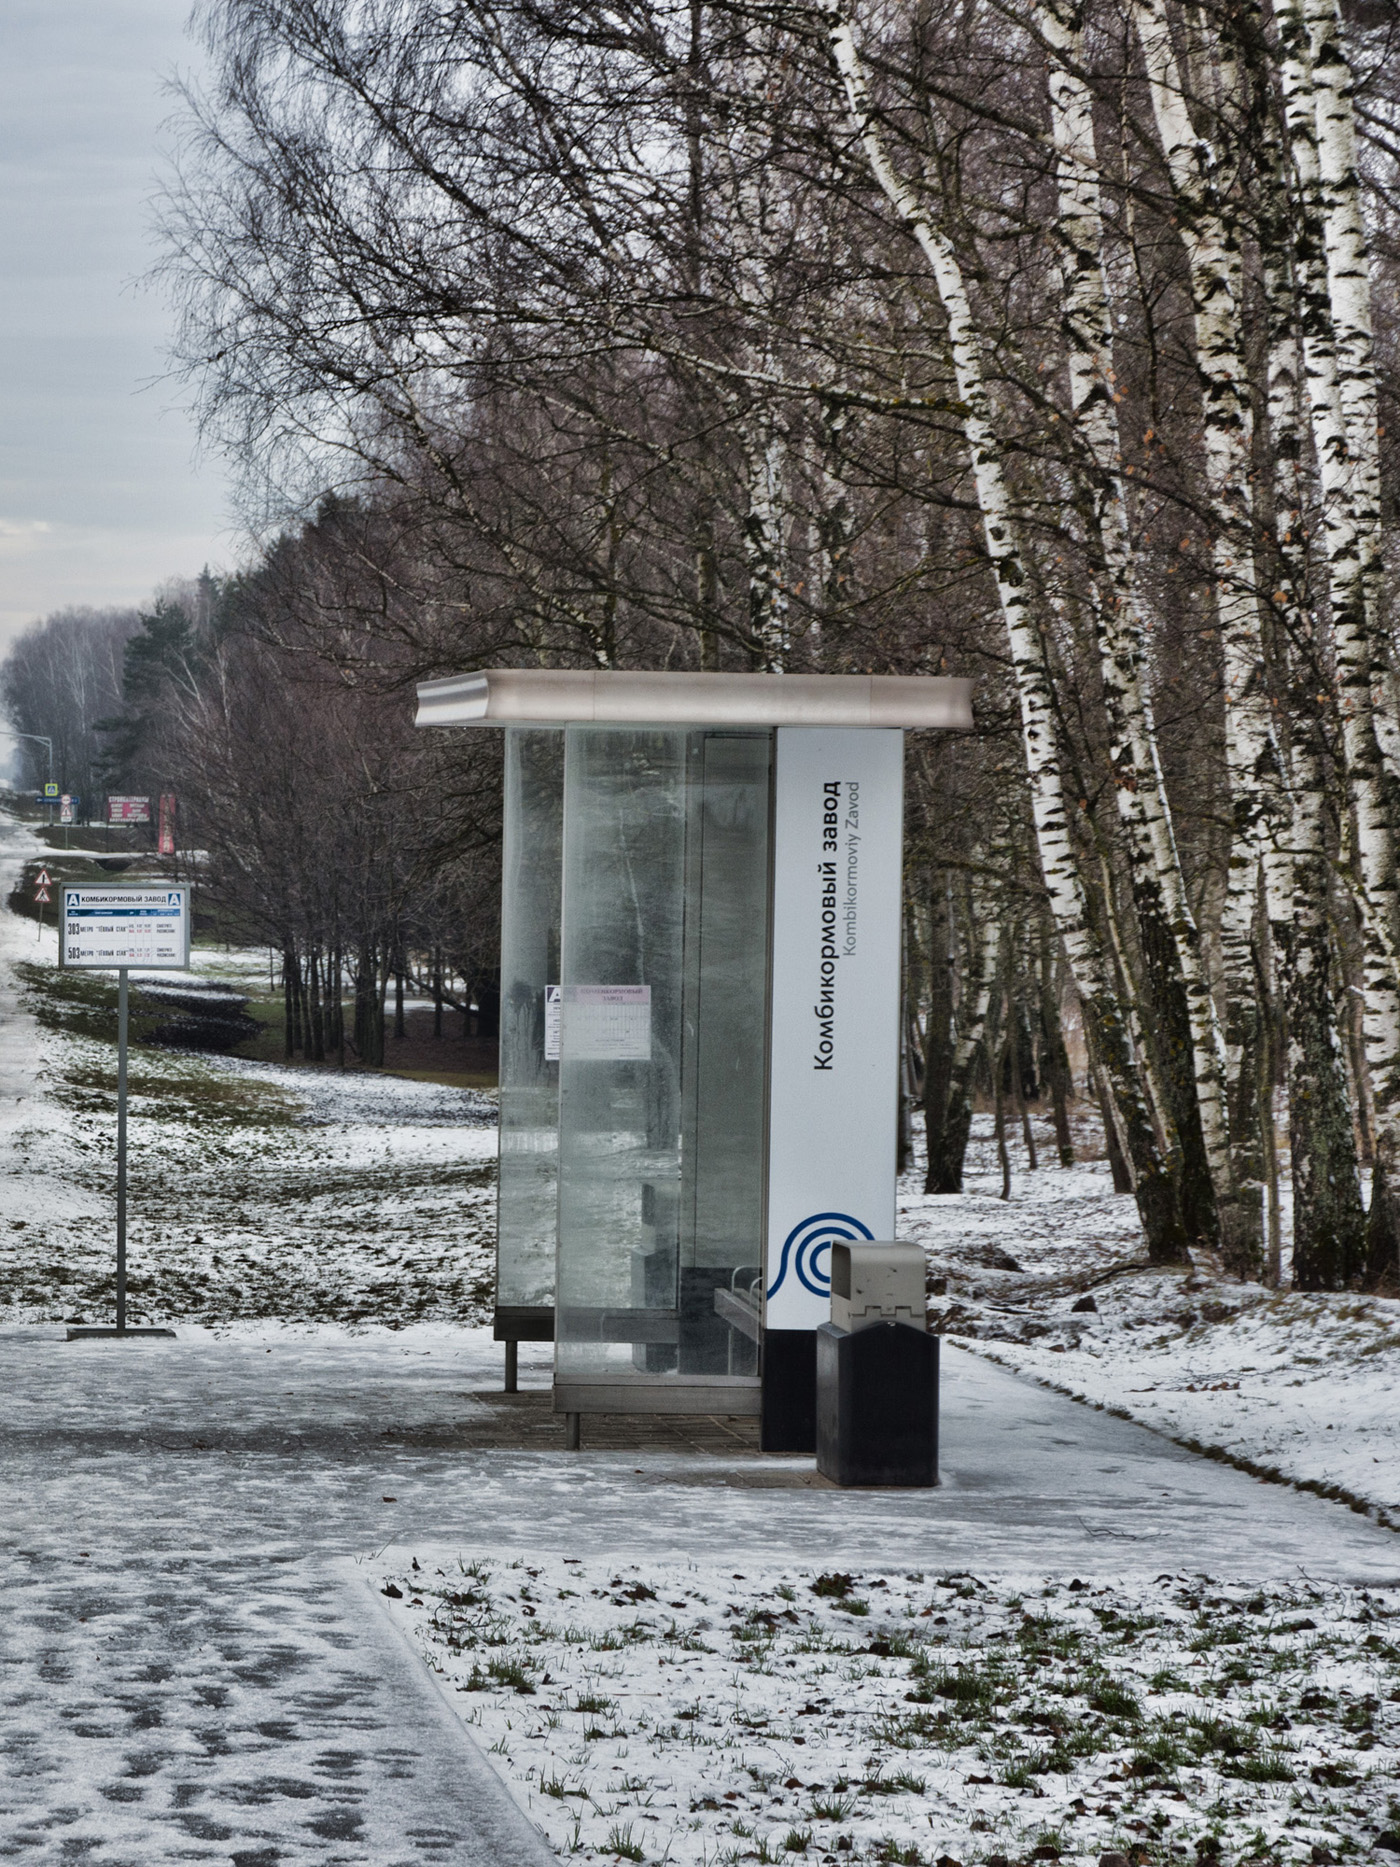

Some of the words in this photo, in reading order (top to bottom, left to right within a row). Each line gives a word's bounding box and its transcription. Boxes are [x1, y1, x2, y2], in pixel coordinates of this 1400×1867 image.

[823, 781, 841, 852] завод
[845, 781, 860, 830] Zavod
[81, 895, 143, 903] КОМБИКОРМОВЫЙ
[143, 895, 167, 903] ЗАВОД
[843, 834, 862, 957] Kombikormoviy
[68, 923, 80, 935] 303
[68, 947, 80, 959] 503
[814, 862, 840, 1071] Комбикормовый
